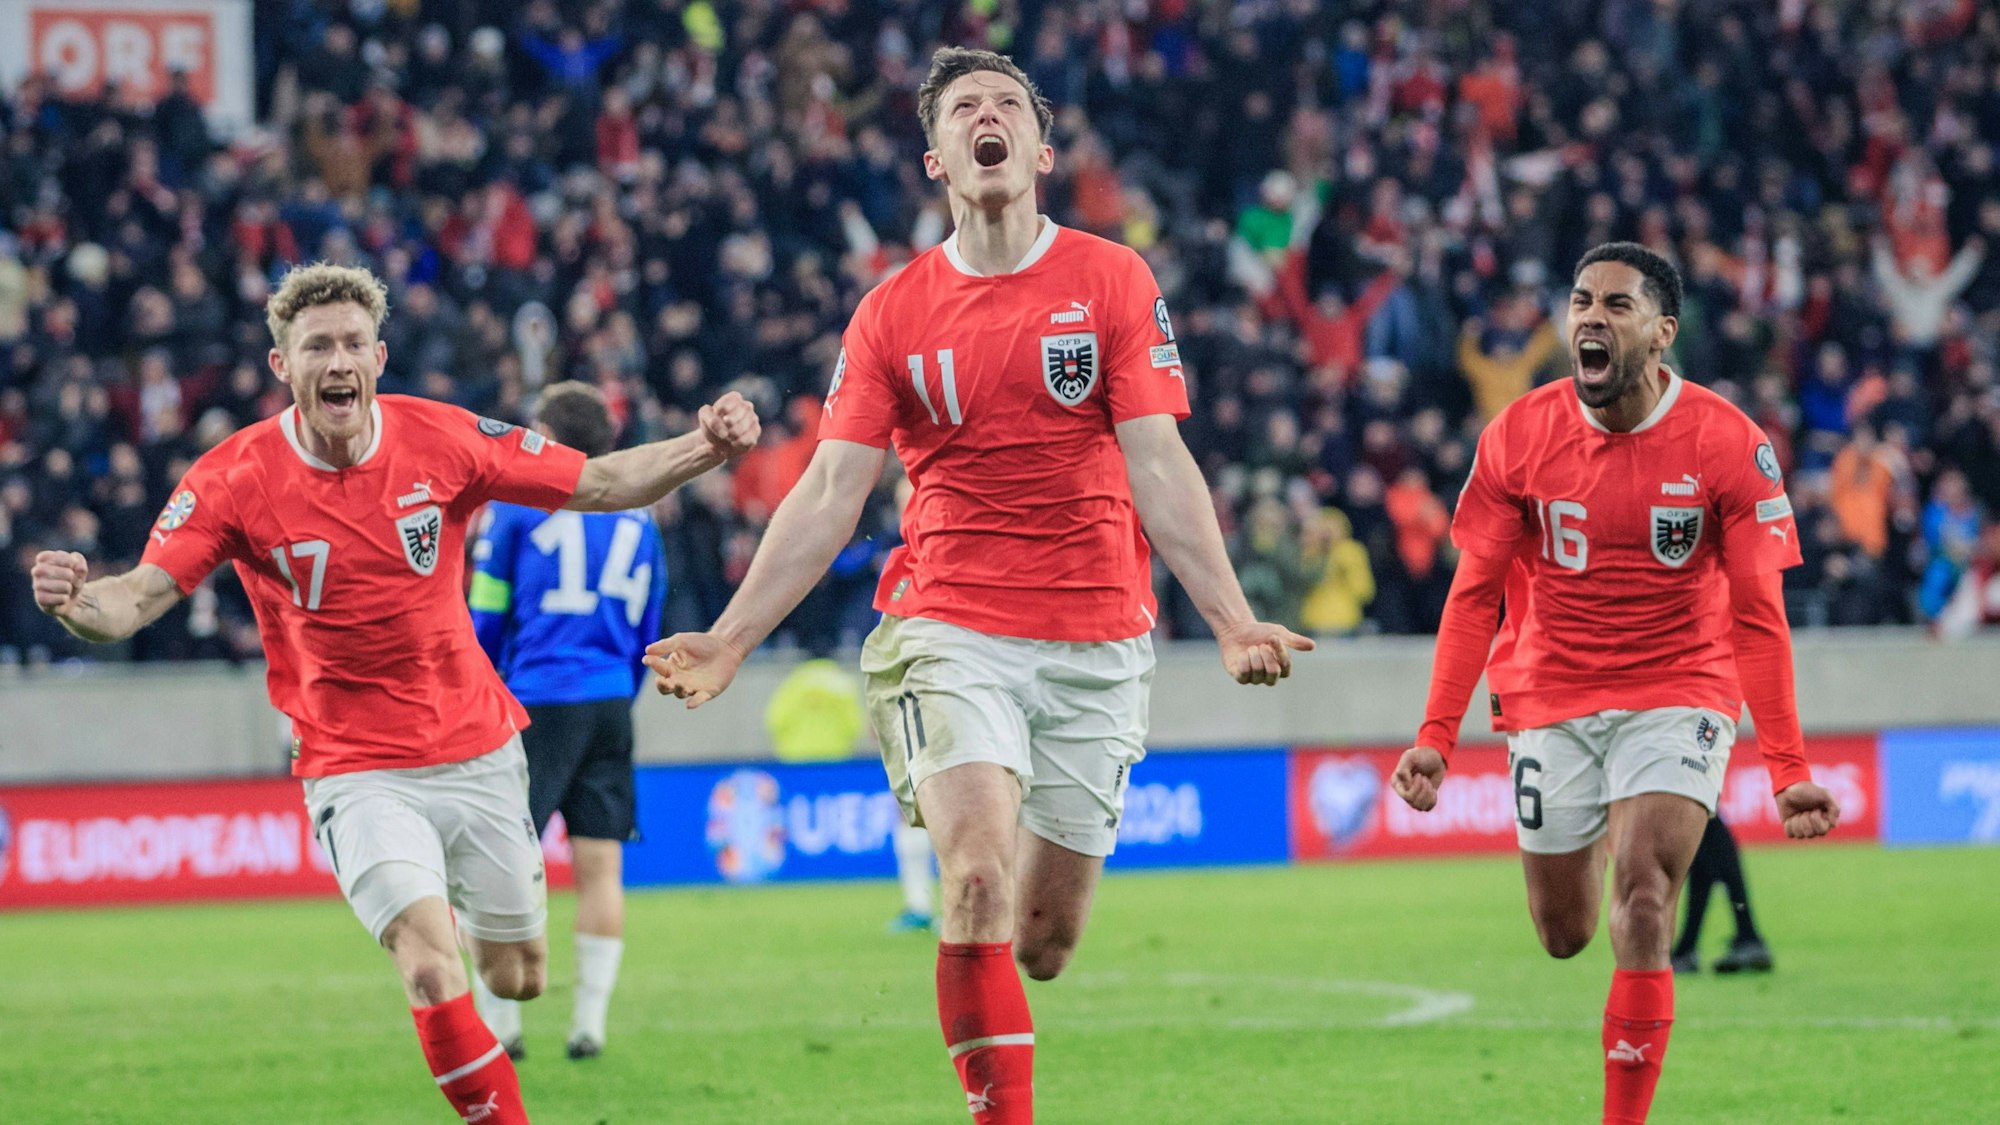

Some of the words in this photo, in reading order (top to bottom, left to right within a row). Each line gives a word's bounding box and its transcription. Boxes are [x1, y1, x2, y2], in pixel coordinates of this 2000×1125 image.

[41, 20, 204, 93] ORF
[1050, 310, 1085, 325] PUMA
[907, 348, 963, 426] 11
[1661, 482, 1695, 496] PUMA
[530, 508, 653, 629] 14
[1535, 498, 1588, 572] 16
[270, 539, 332, 611] 17
[20, 812, 299, 884] EUROPEAN
[788, 791, 898, 855] UEF
